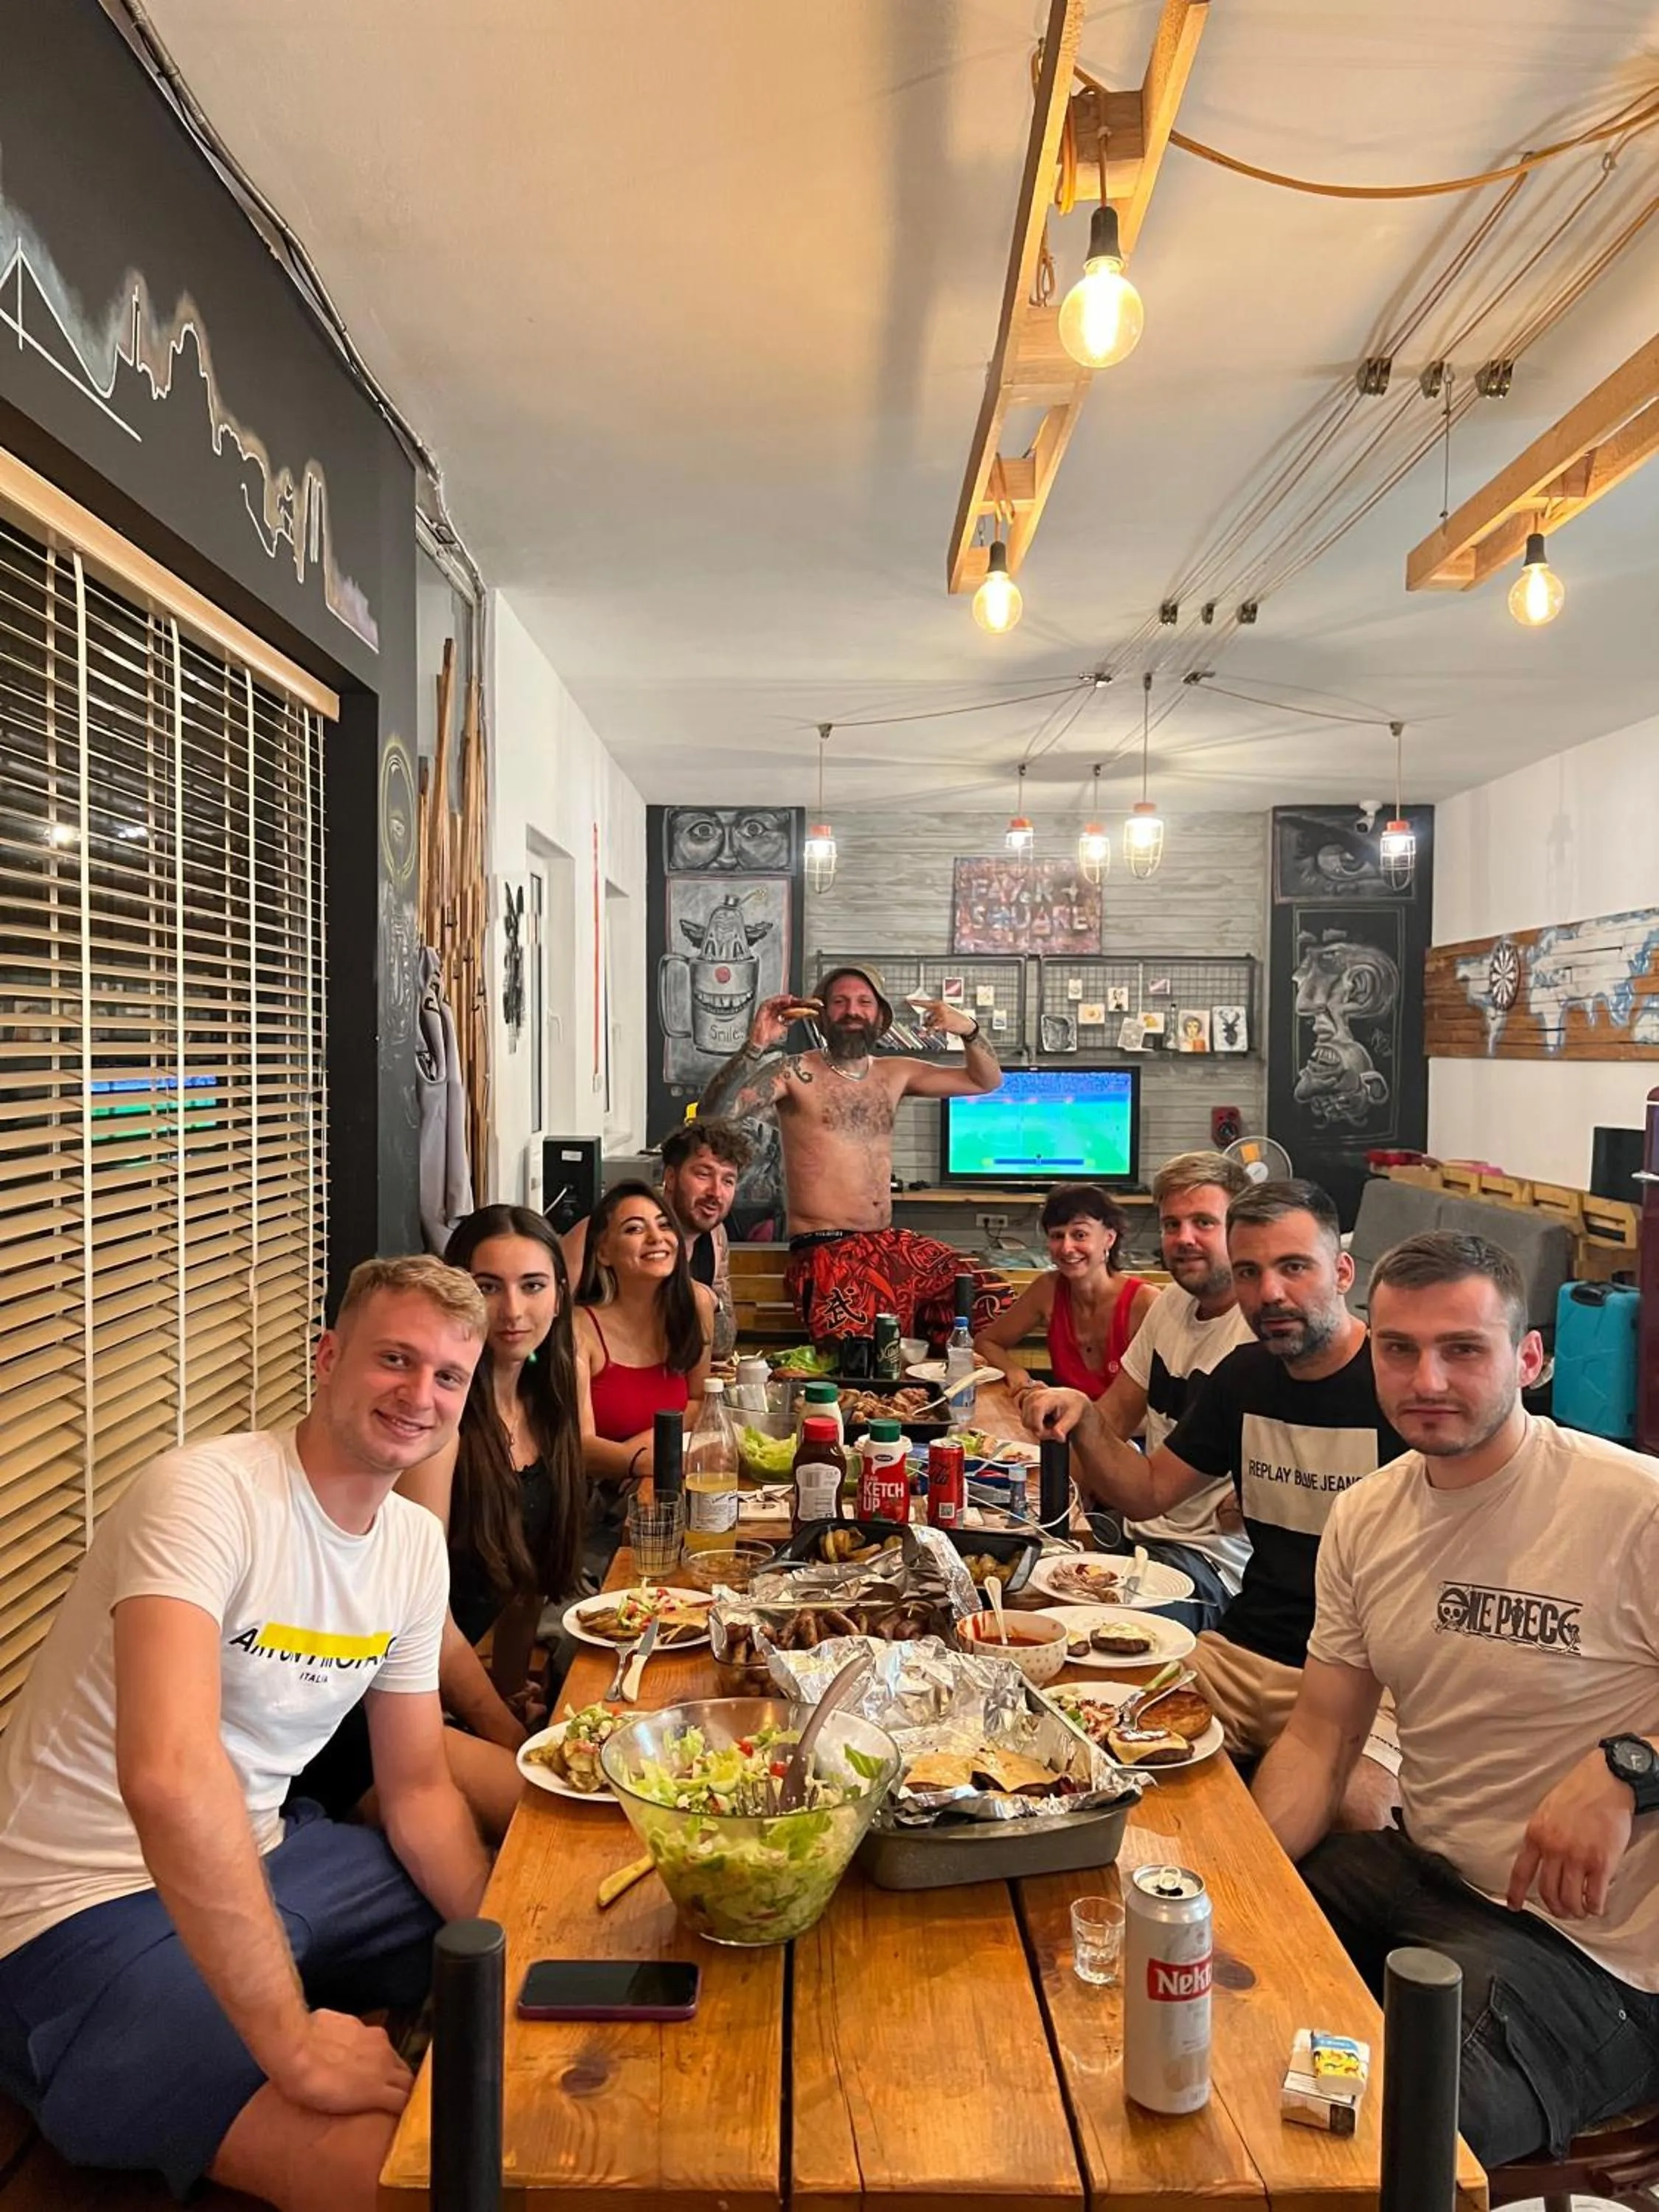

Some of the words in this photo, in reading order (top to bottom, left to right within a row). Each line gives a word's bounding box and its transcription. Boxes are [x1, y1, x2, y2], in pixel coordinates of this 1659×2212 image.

[1248, 1458, 1291, 1484] REPLAY
[1320, 1475, 1363, 1492] JEAN
[863, 1482, 905, 1498] KETCH
[863, 1497, 880, 1512] UP
[1438, 1587, 1496, 1632] ONE
[1495, 1594, 1582, 1649] PIECE
